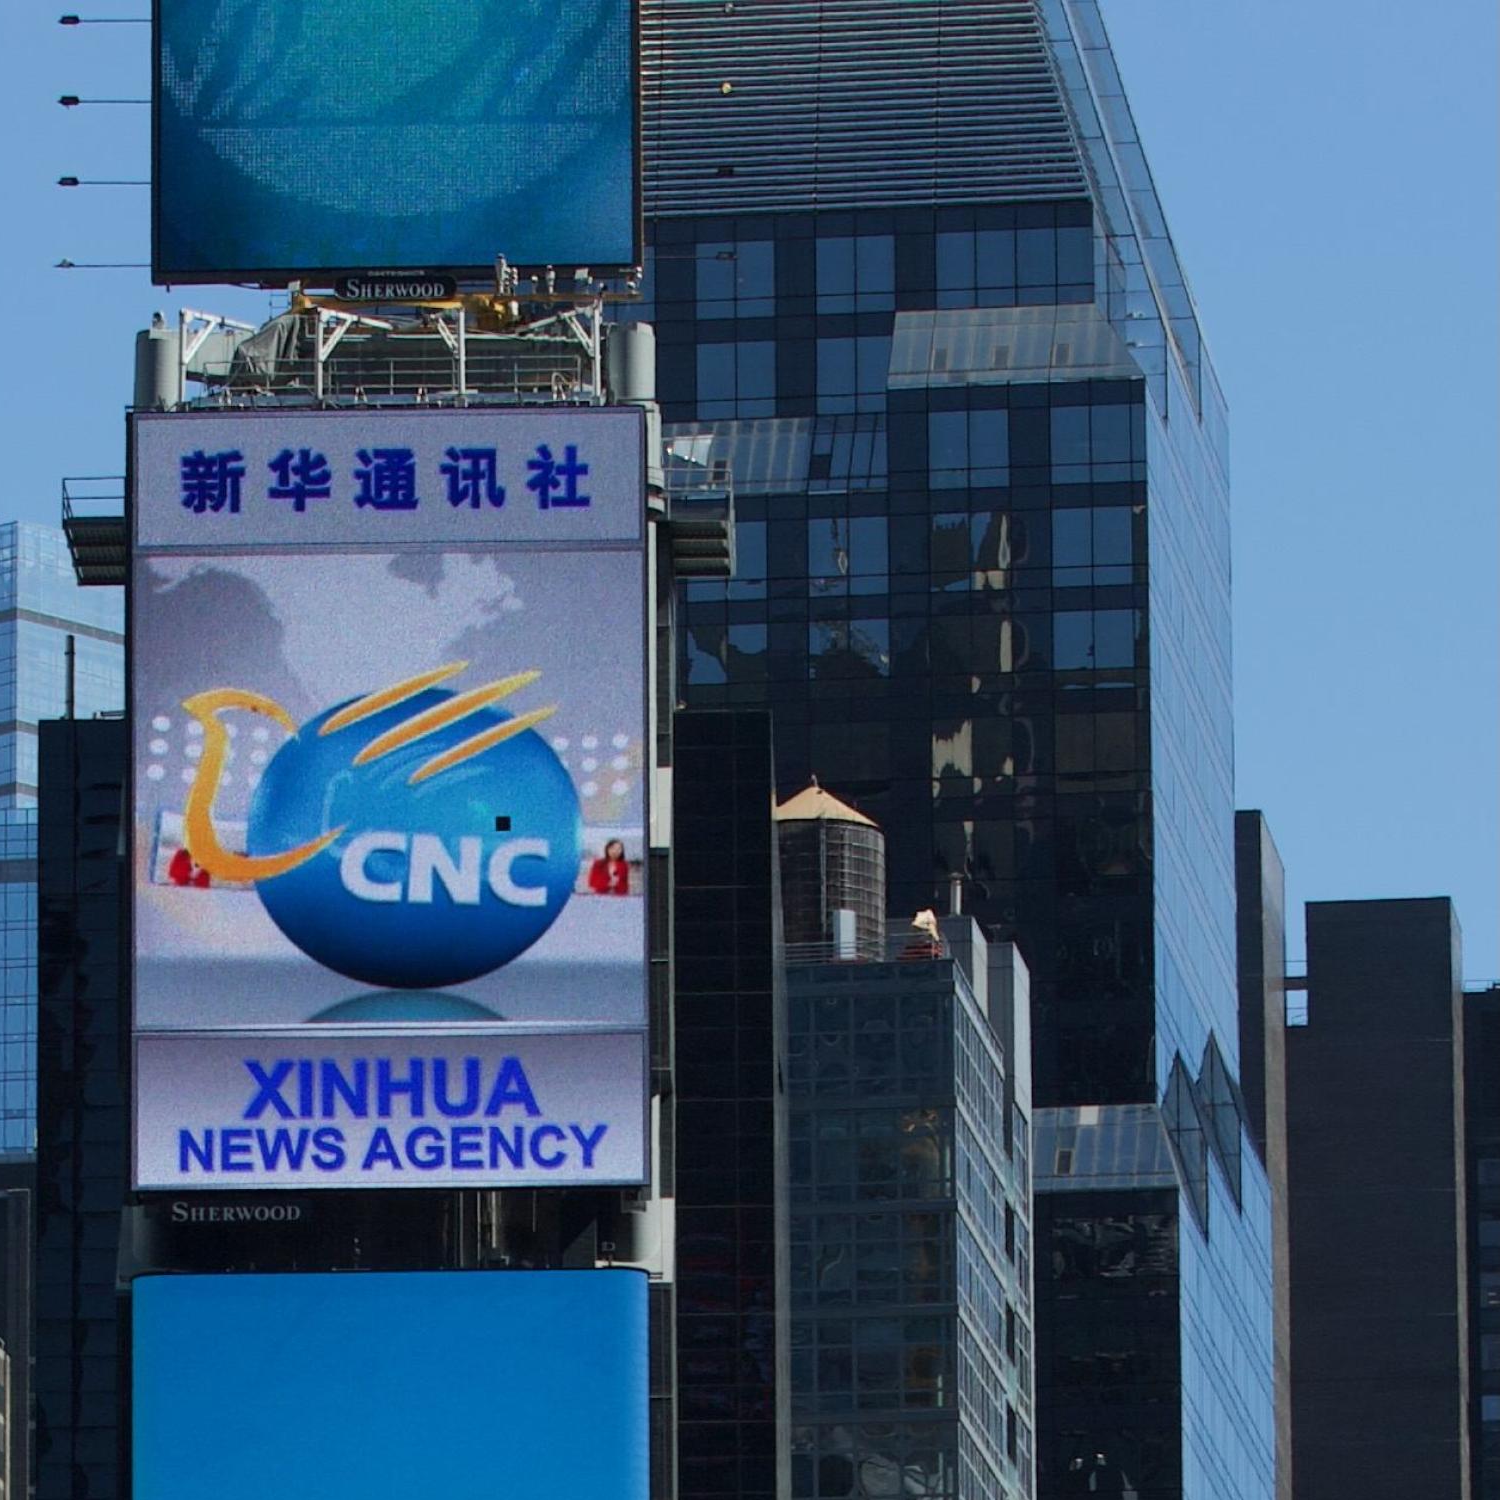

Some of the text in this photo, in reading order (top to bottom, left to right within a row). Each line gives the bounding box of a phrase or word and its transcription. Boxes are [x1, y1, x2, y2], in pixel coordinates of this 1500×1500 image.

[346, 278, 445, 298] SHERWOOD
[181, 445, 590, 513] 新华通讯社
[339, 830, 550, 907] CNC
[243, 1057, 541, 1120] XINHUA
[179, 1124, 608, 1172] NEWS AGENCY
[171, 1200, 301, 1223] SHERWOOD
